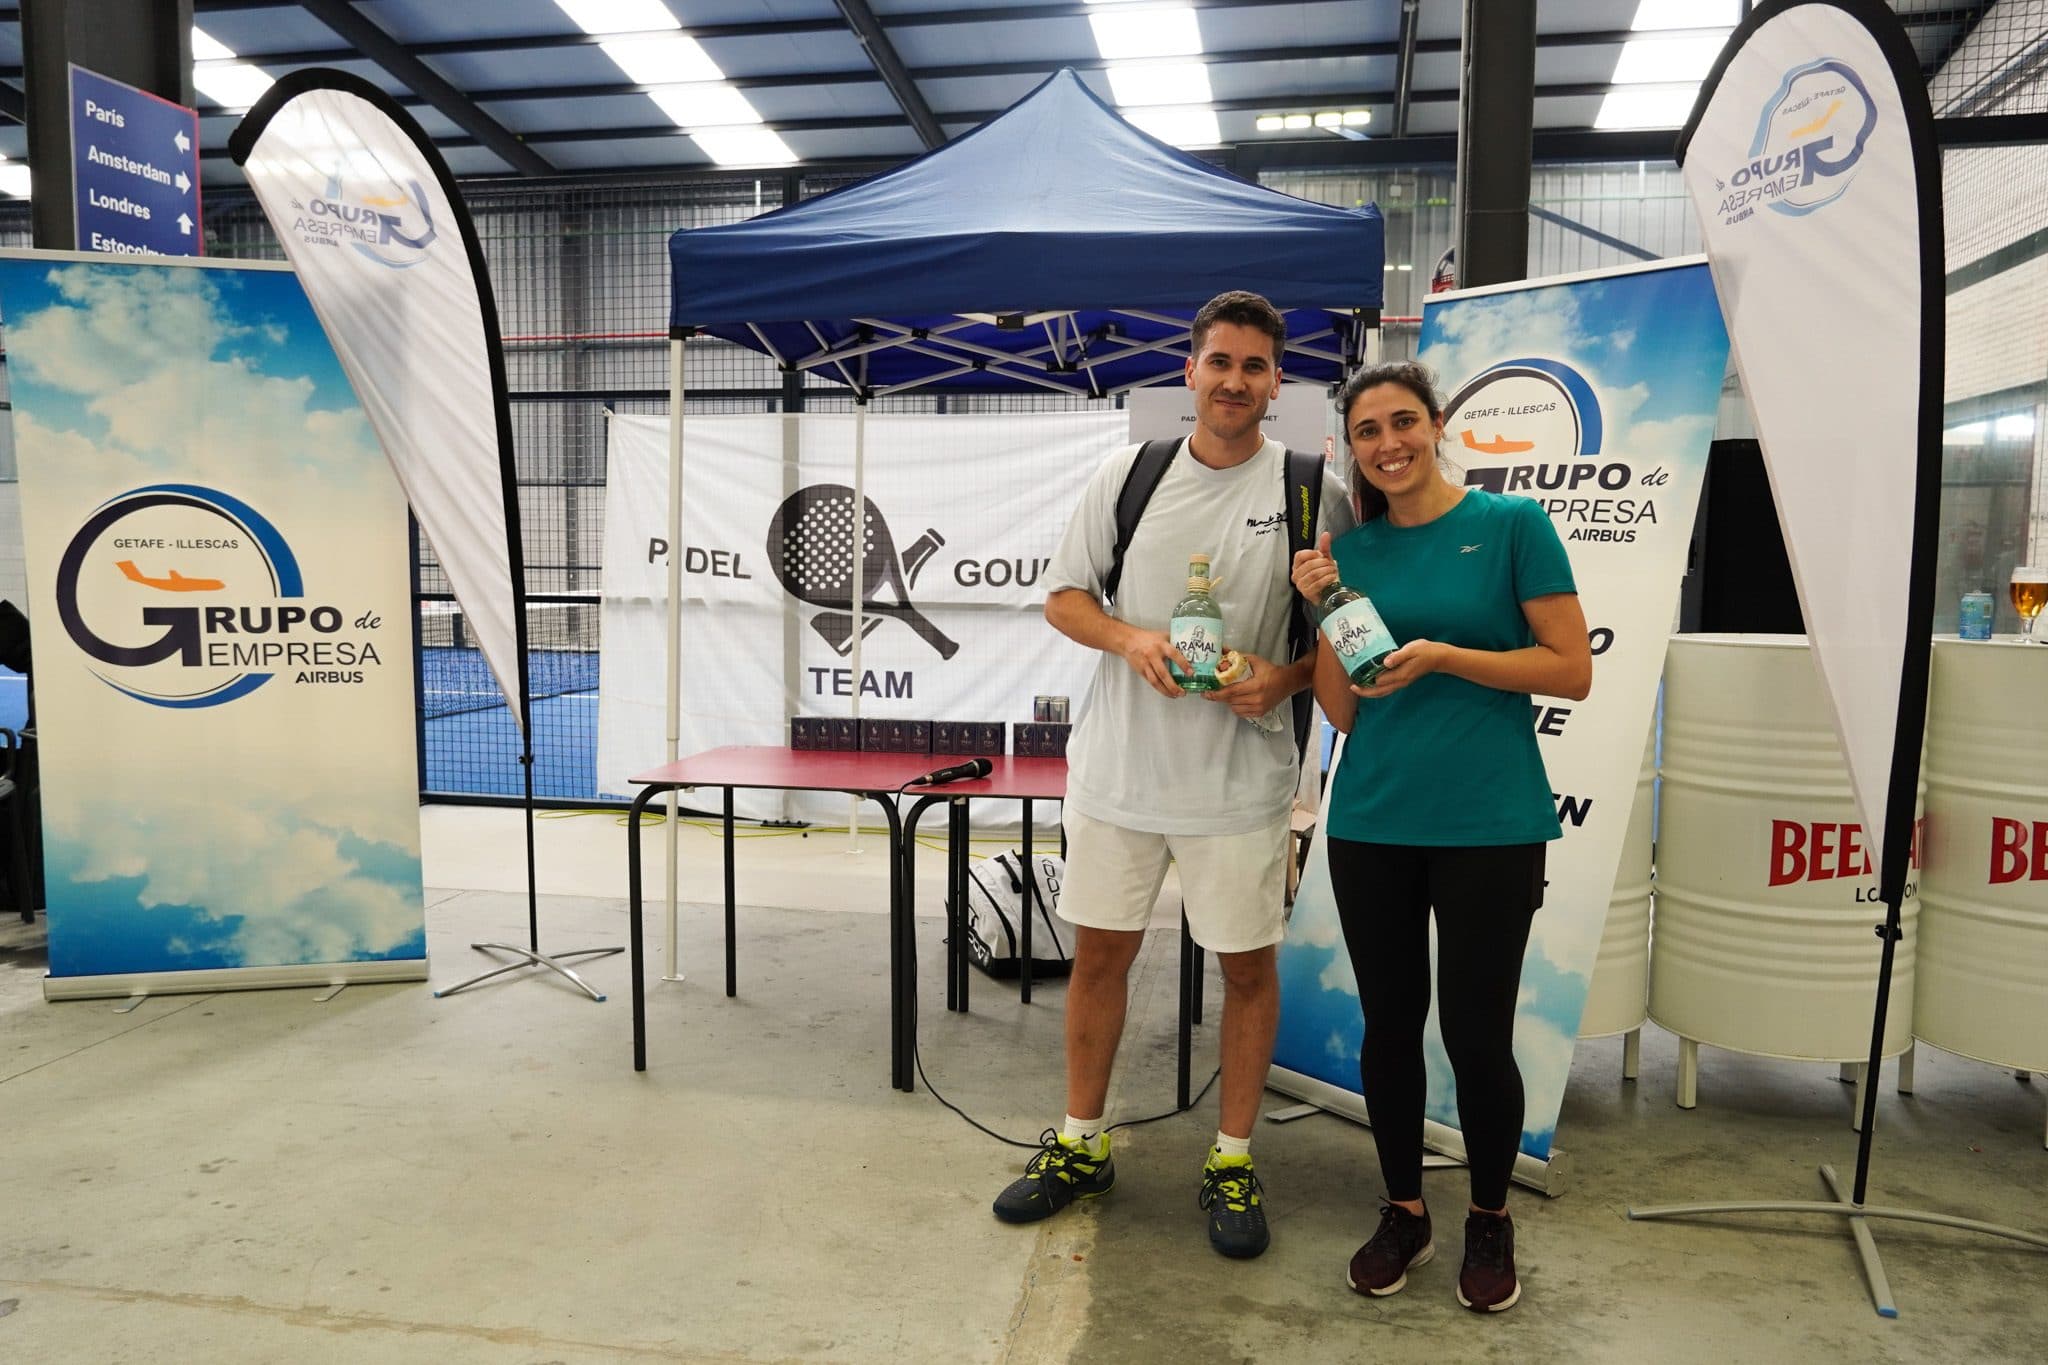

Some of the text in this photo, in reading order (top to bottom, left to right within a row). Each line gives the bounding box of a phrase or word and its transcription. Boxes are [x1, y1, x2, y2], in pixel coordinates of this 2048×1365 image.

[85, 100, 125, 128] Paris
[88, 145, 171, 185] Amsterdam
[89, 188, 151, 220] Londres
[91, 232, 166, 257] Estocol
[1464, 407, 1500, 420] GETAFE
[1507, 402, 1557, 416] ILLESCAS
[1641, 466, 1669, 487] de
[1538, 499, 1657, 524] PRESA
[114, 538, 165, 549] GETAFE
[176, 539, 239, 549] ILLESCAS
[1568, 528, 1636, 543] AIRBUS
[648, 538, 1051, 587] PDEL GOU
[354, 610, 382, 629] de
[208, 642, 381, 666] EMPRESA
[295, 671, 364, 684] AIRBUS
[808, 667, 913, 698] TEAM
